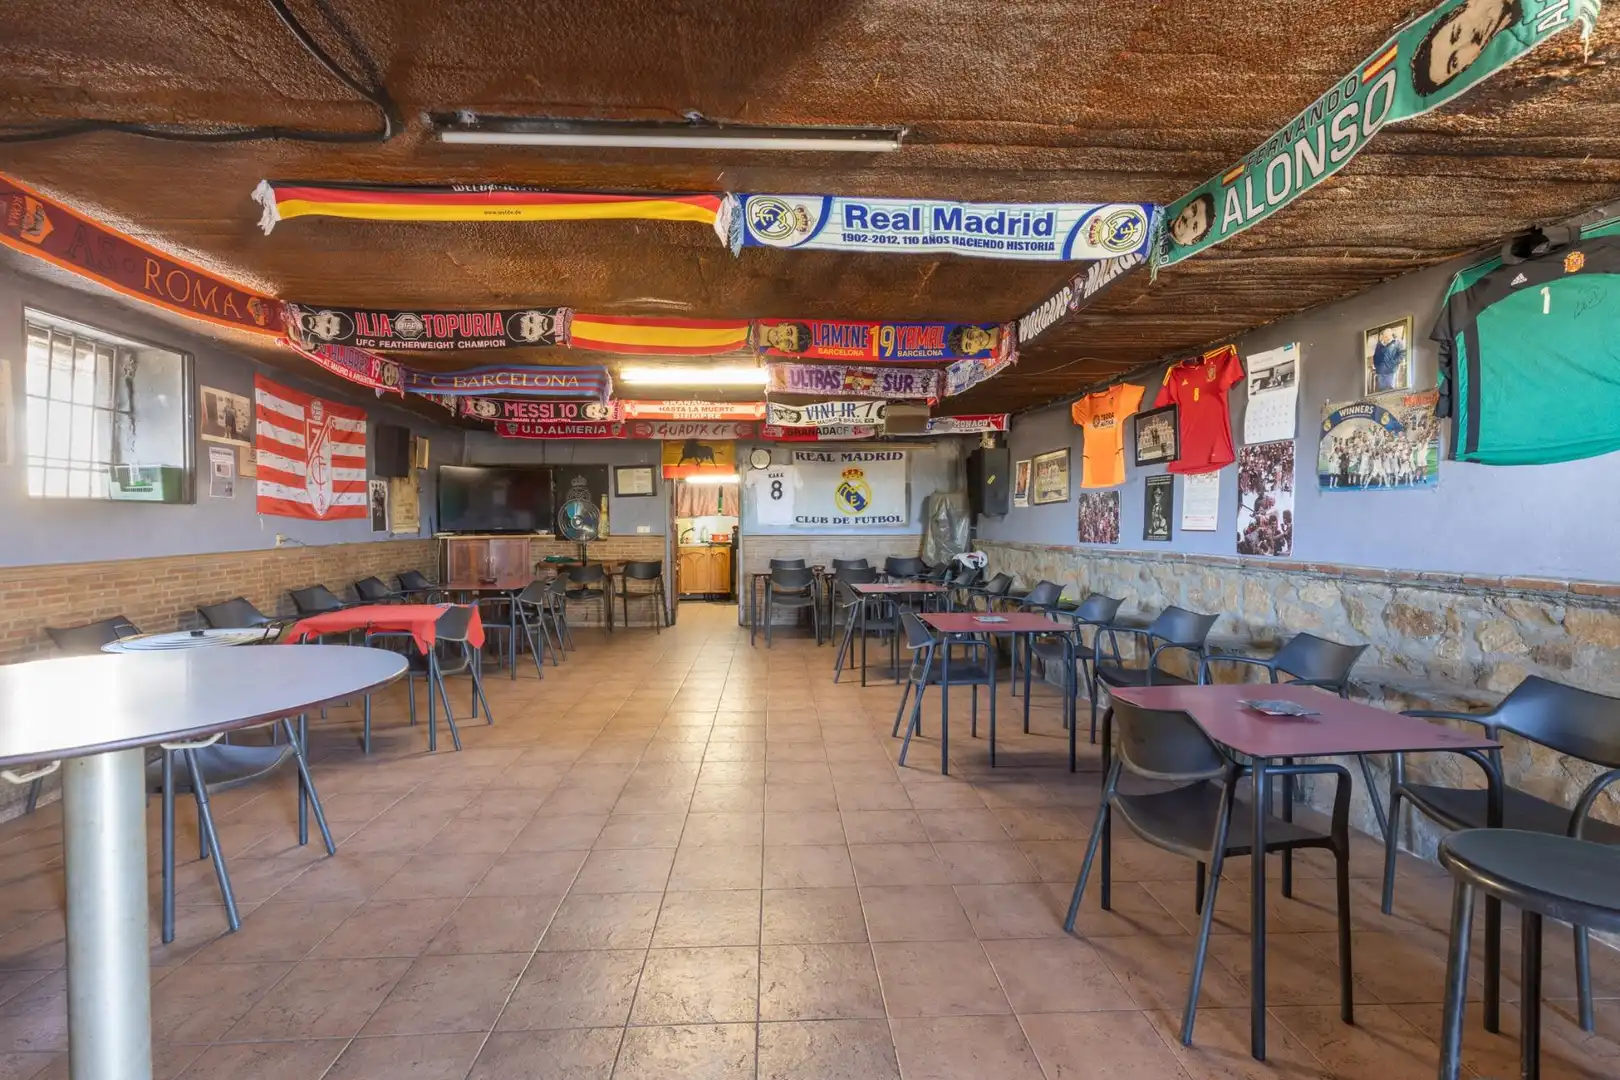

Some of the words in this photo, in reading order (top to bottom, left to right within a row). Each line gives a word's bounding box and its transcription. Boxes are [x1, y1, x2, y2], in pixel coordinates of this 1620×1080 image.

[1245, 74, 1359, 174] FERNANDO
[1220, 69, 1397, 235] ALONSO
[844, 203, 921, 233] Real
[933, 207, 1055, 238] Madrid
[900, 235, 920, 246] 110
[921, 233, 951, 247] AÑOS
[951, 236, 1005, 250] HACIENDO
[1006, 238, 1056, 252] HISTORIA
[143, 255, 243, 320] ROMA
[1540, 286, 1551, 315] 1
[354, 312, 393, 338] ILIA
[422, 312, 506, 338] TOPURIA
[356, 338, 376, 347] UFC
[379, 339, 455, 349] FEATHERWEIGHT
[457, 338, 507, 349] CHAMPION
[811, 323, 869, 350] LAMINE
[869, 325, 896, 358] 19
[896, 324, 947, 350] YAMAL
[818, 348, 865, 357] BARCELONA
[897, 349, 944, 358] BARCELONA
[371, 358, 382, 380] 19
[453, 372, 580, 389] BARCELONA
[790, 369, 842, 391] ULTRAS
[882, 373, 915, 393] SUR
[503, 403, 556, 418] MESSI
[558, 403, 578, 418] 10
[806, 404, 836, 420] VINI
[839, 402, 860, 419] JR.
[1338, 404, 1375, 418] WINNERS
[657, 422, 710, 438] GUADIX
[712, 424, 731, 437] CF
[954, 419, 989, 428] MONACO
[795, 451, 836, 462] REAL
[840, 451, 904, 462] MADRID
[770, 480, 783, 500] 8
[795, 515, 829, 524] CLUB
[832, 516, 850, 525] DE
[854, 515, 904, 524] FUTBOL
